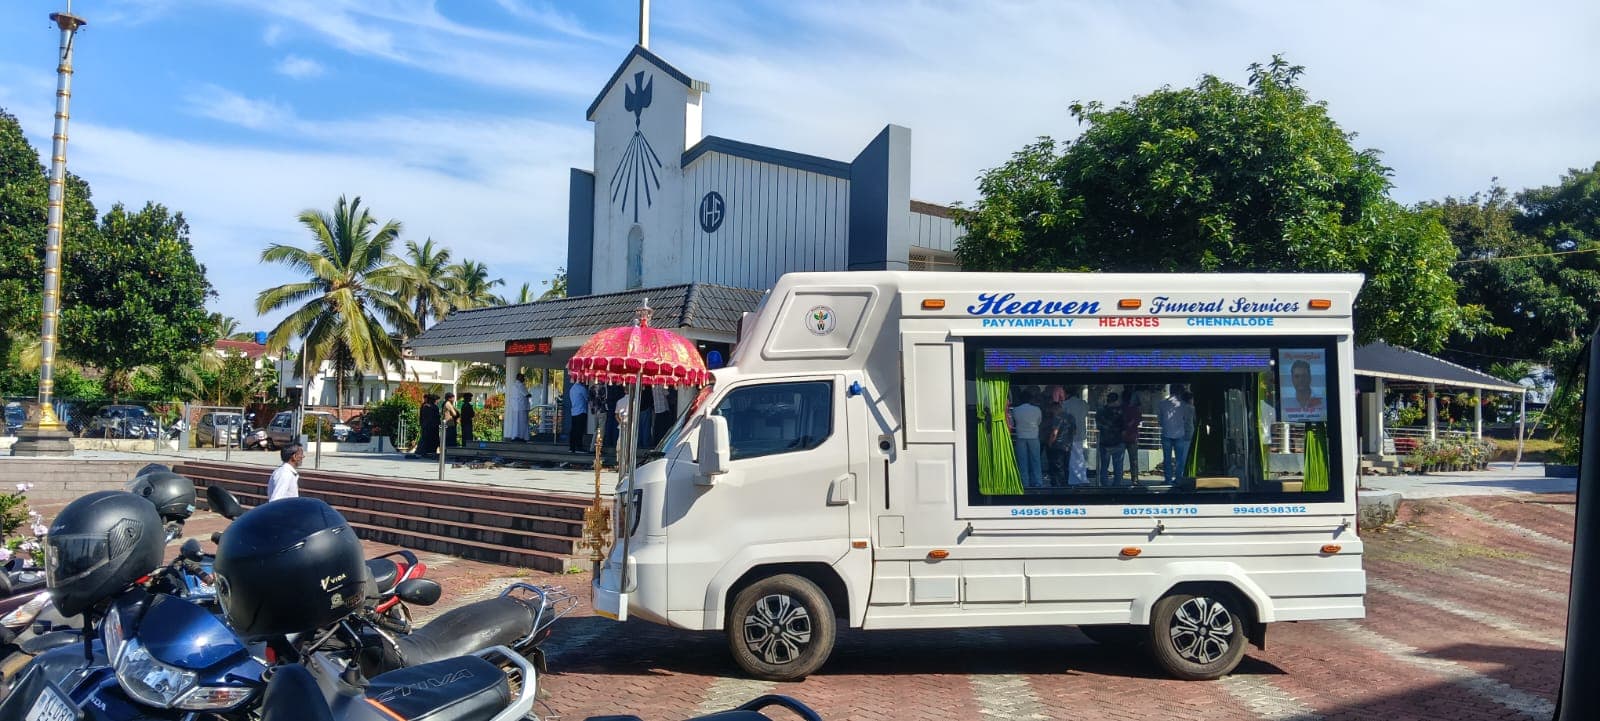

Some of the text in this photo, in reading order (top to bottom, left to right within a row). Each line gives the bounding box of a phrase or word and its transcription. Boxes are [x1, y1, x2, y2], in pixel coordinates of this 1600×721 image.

[967, 292, 1300, 315] Heaven Funeral Services
[982, 316, 1274, 328] PAYYAMPALLY HEARSES CHENNALODE
[1010, 508, 1087, 516] 9495616843
[1122, 507, 1198, 515] 8075341710
